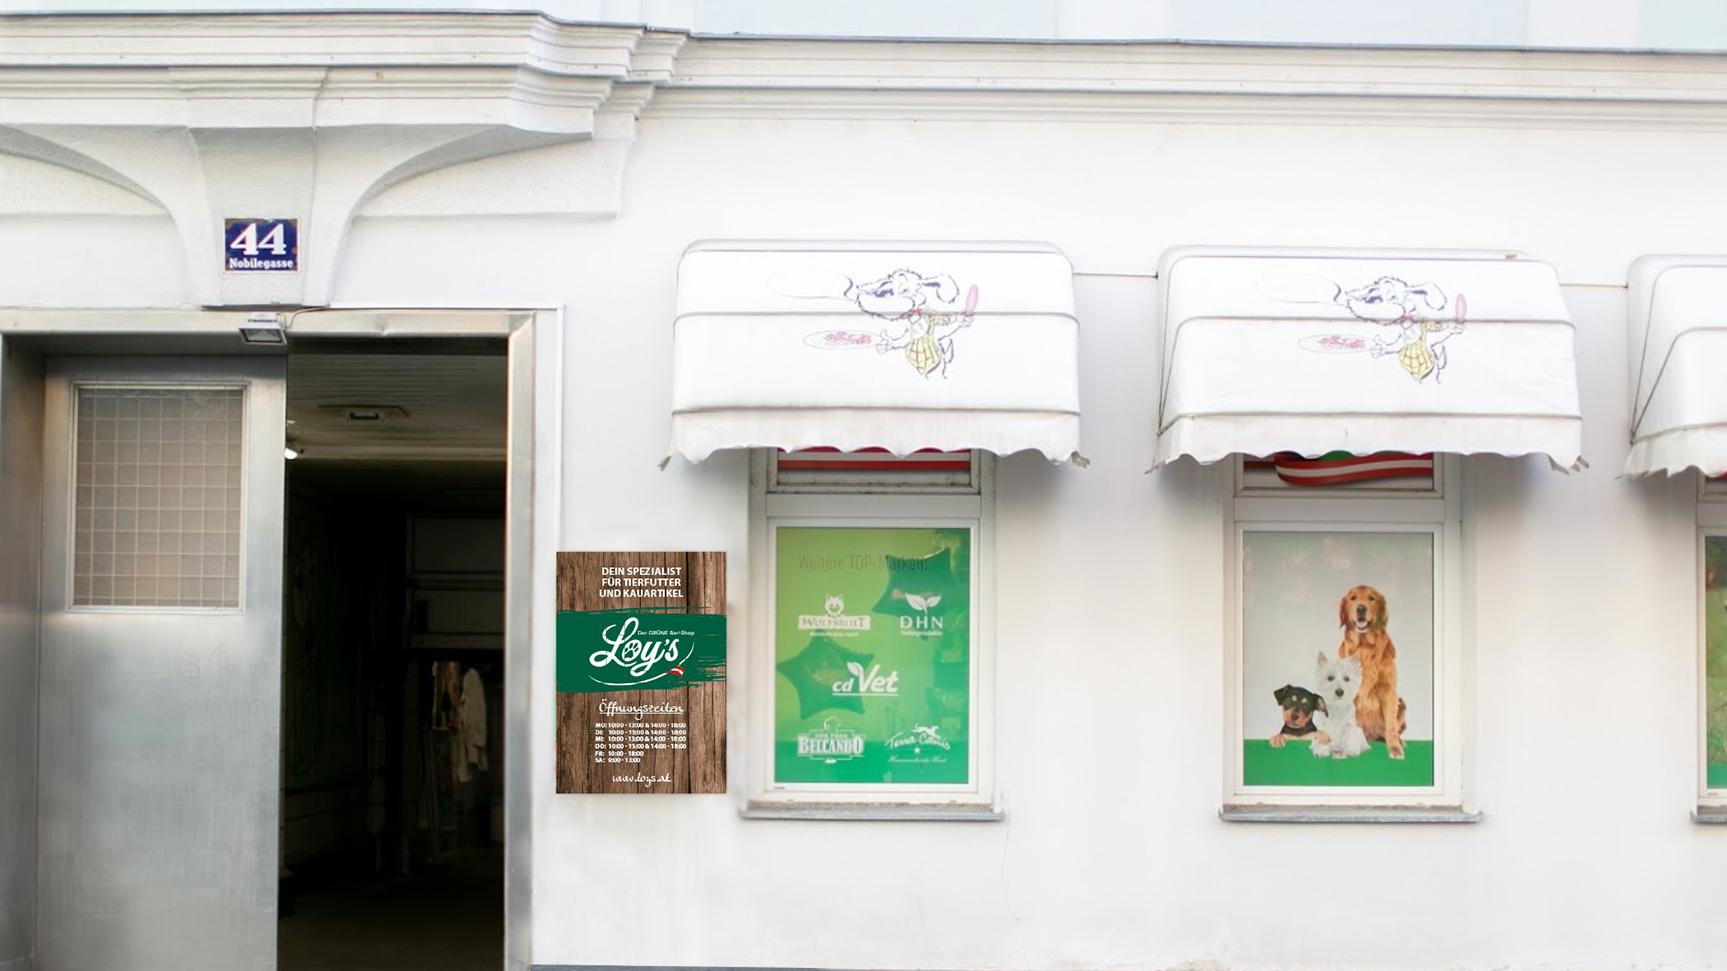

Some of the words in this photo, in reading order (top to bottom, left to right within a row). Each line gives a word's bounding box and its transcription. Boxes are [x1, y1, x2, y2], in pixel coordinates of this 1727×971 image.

[230, 222, 287, 255] 44
[229, 257, 294, 269] Nobilegasse
[602, 567, 624, 576] DEIN
[627, 567, 682, 576] SPEZIALIST
[602, 577, 621, 587] FÜR
[623, 578, 681, 587] TIERFUTTER
[599, 589, 621, 598] UND
[623, 589, 684, 598] KAUARTIKEL
[900, 616, 944, 630] DHN
[589, 616, 680, 677] Loy's
[599, 698, 684, 721] Öffnungszeiten
[798, 735, 865, 755] BELCANDO
